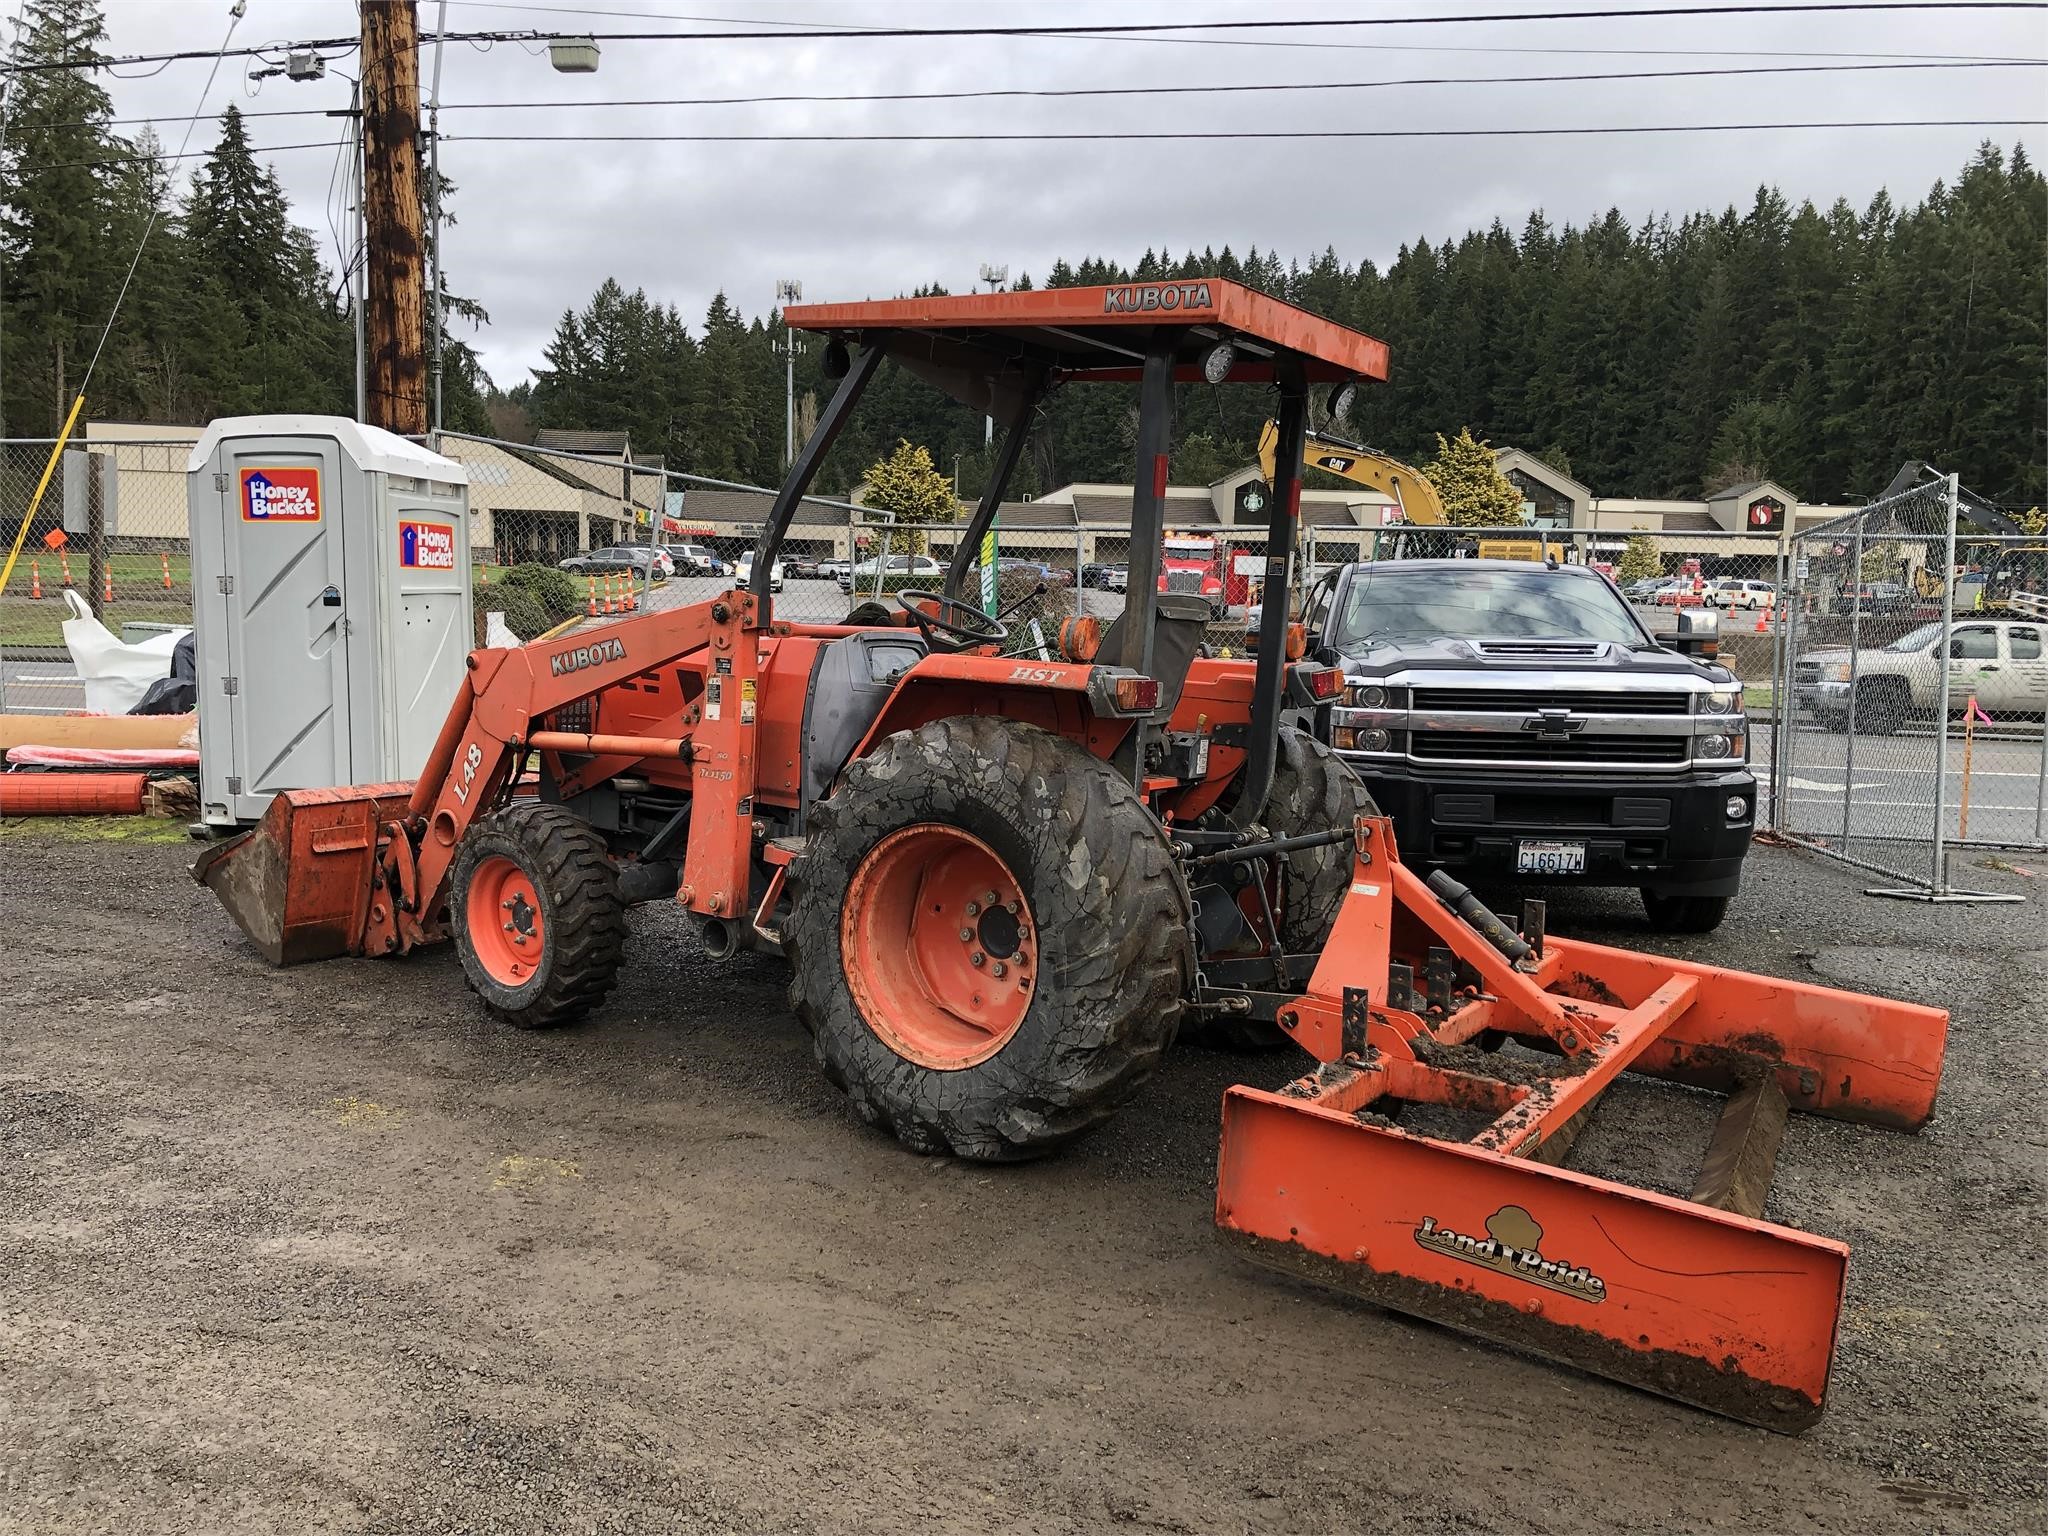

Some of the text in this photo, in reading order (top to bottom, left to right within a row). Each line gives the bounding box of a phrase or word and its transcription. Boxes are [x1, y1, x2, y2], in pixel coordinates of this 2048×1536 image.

[1104, 283, 1213, 313] KUBOTA
[1329, 458, 1346, 471] CAT
[249, 482, 310, 502] Honey
[251, 499, 316, 516] Bucket
[1937, 492, 1973, 514] DRE
[417, 525, 450, 548] Honey
[418, 547, 453, 567] Bucket
[550, 637, 627, 677] KUBOTA
[1008, 666, 1067, 683] HST
[453, 743, 482, 805] L48
[1520, 852, 1583, 869] C16617W
[1418, 1216, 1605, 1295] Land Pride
